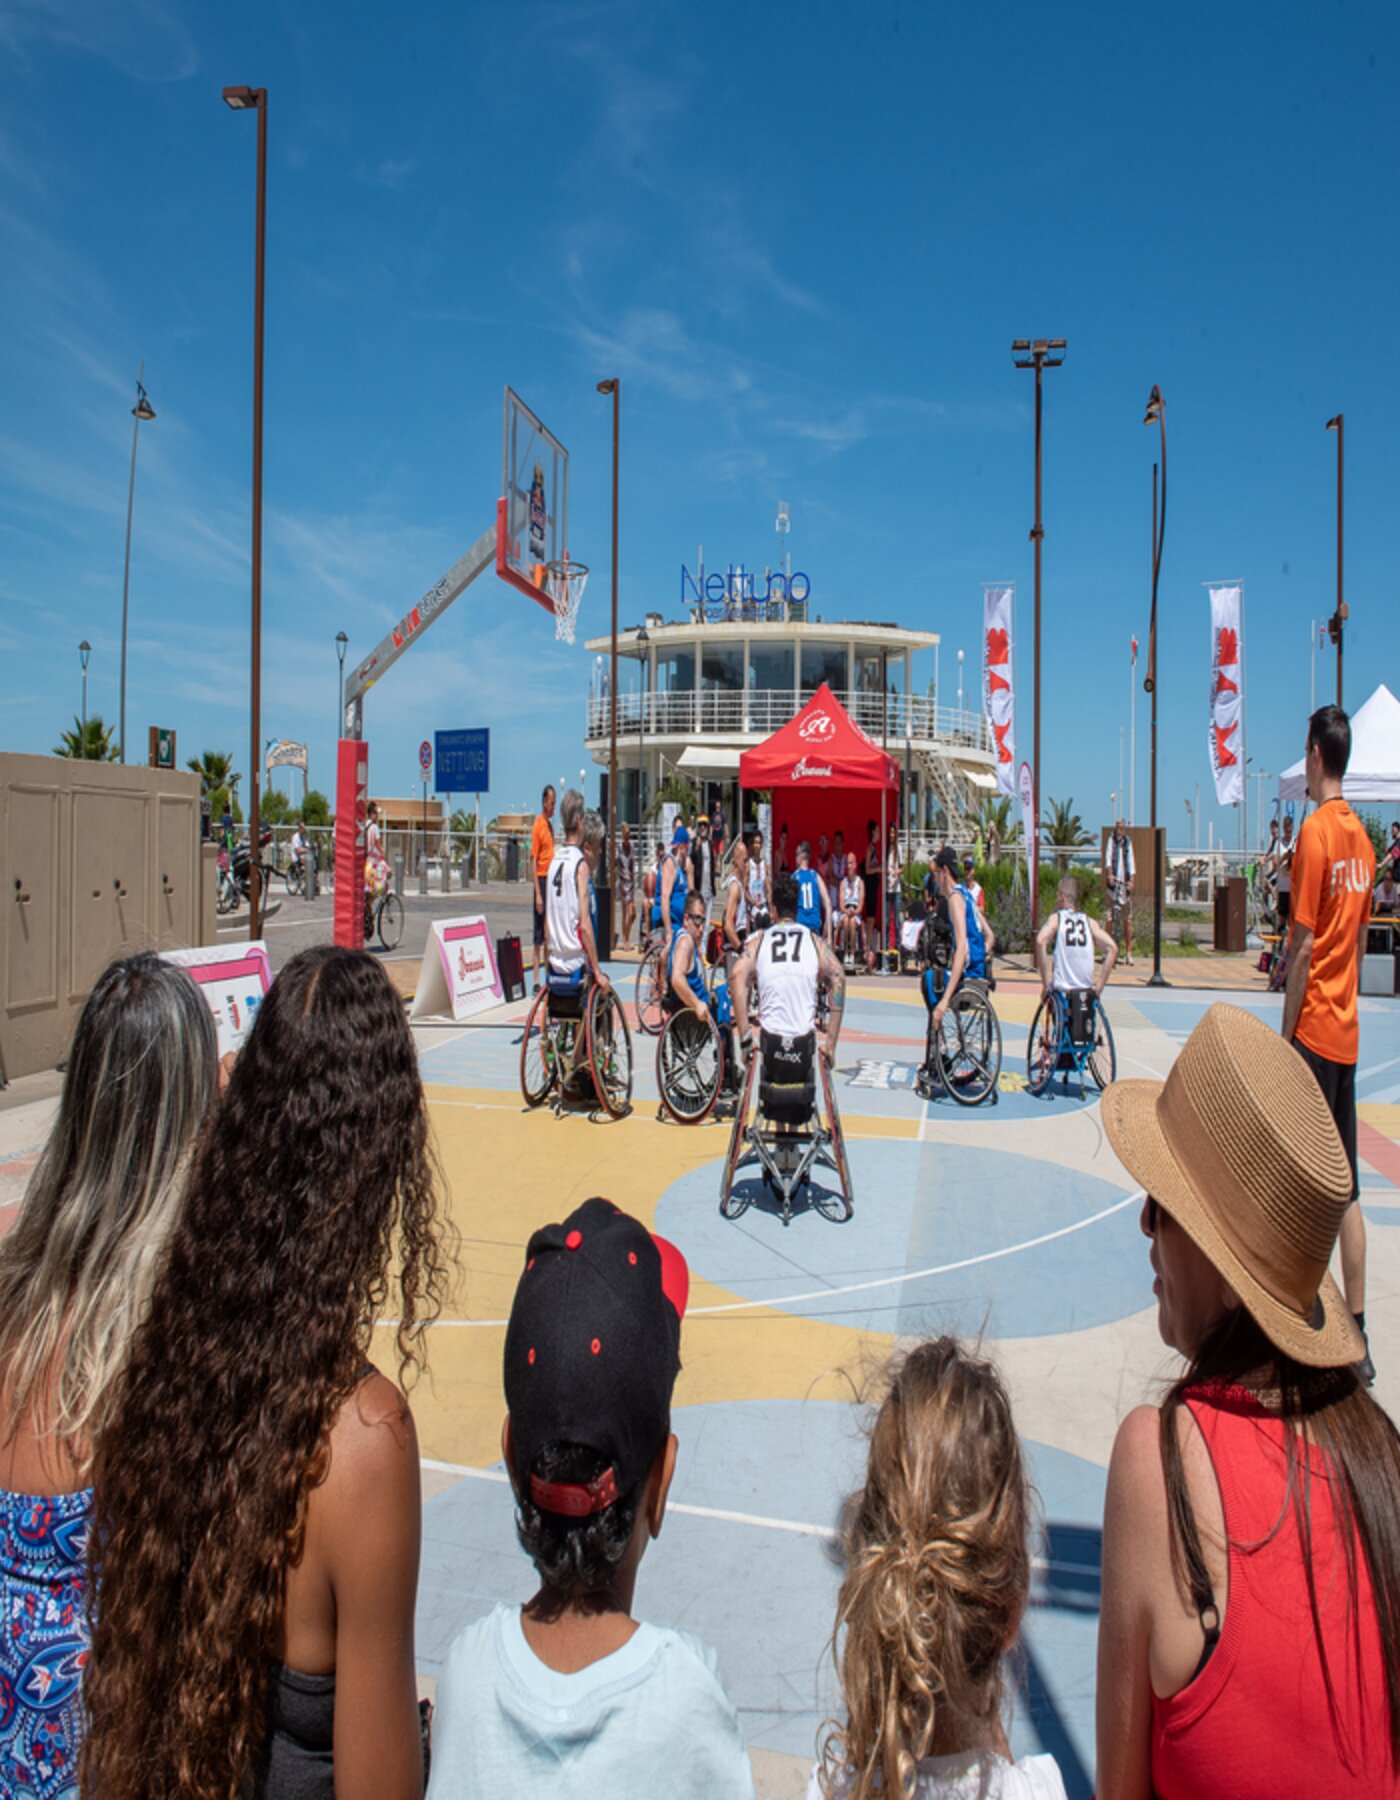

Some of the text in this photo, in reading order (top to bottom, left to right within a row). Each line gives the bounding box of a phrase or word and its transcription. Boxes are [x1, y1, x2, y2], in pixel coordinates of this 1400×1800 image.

[681, 563, 811, 603] Nettuno
[552, 861, 565, 897] 4
[801, 882, 814, 910] 11
[771, 931, 803, 963] 27
[1064, 918, 1087, 948] 23
